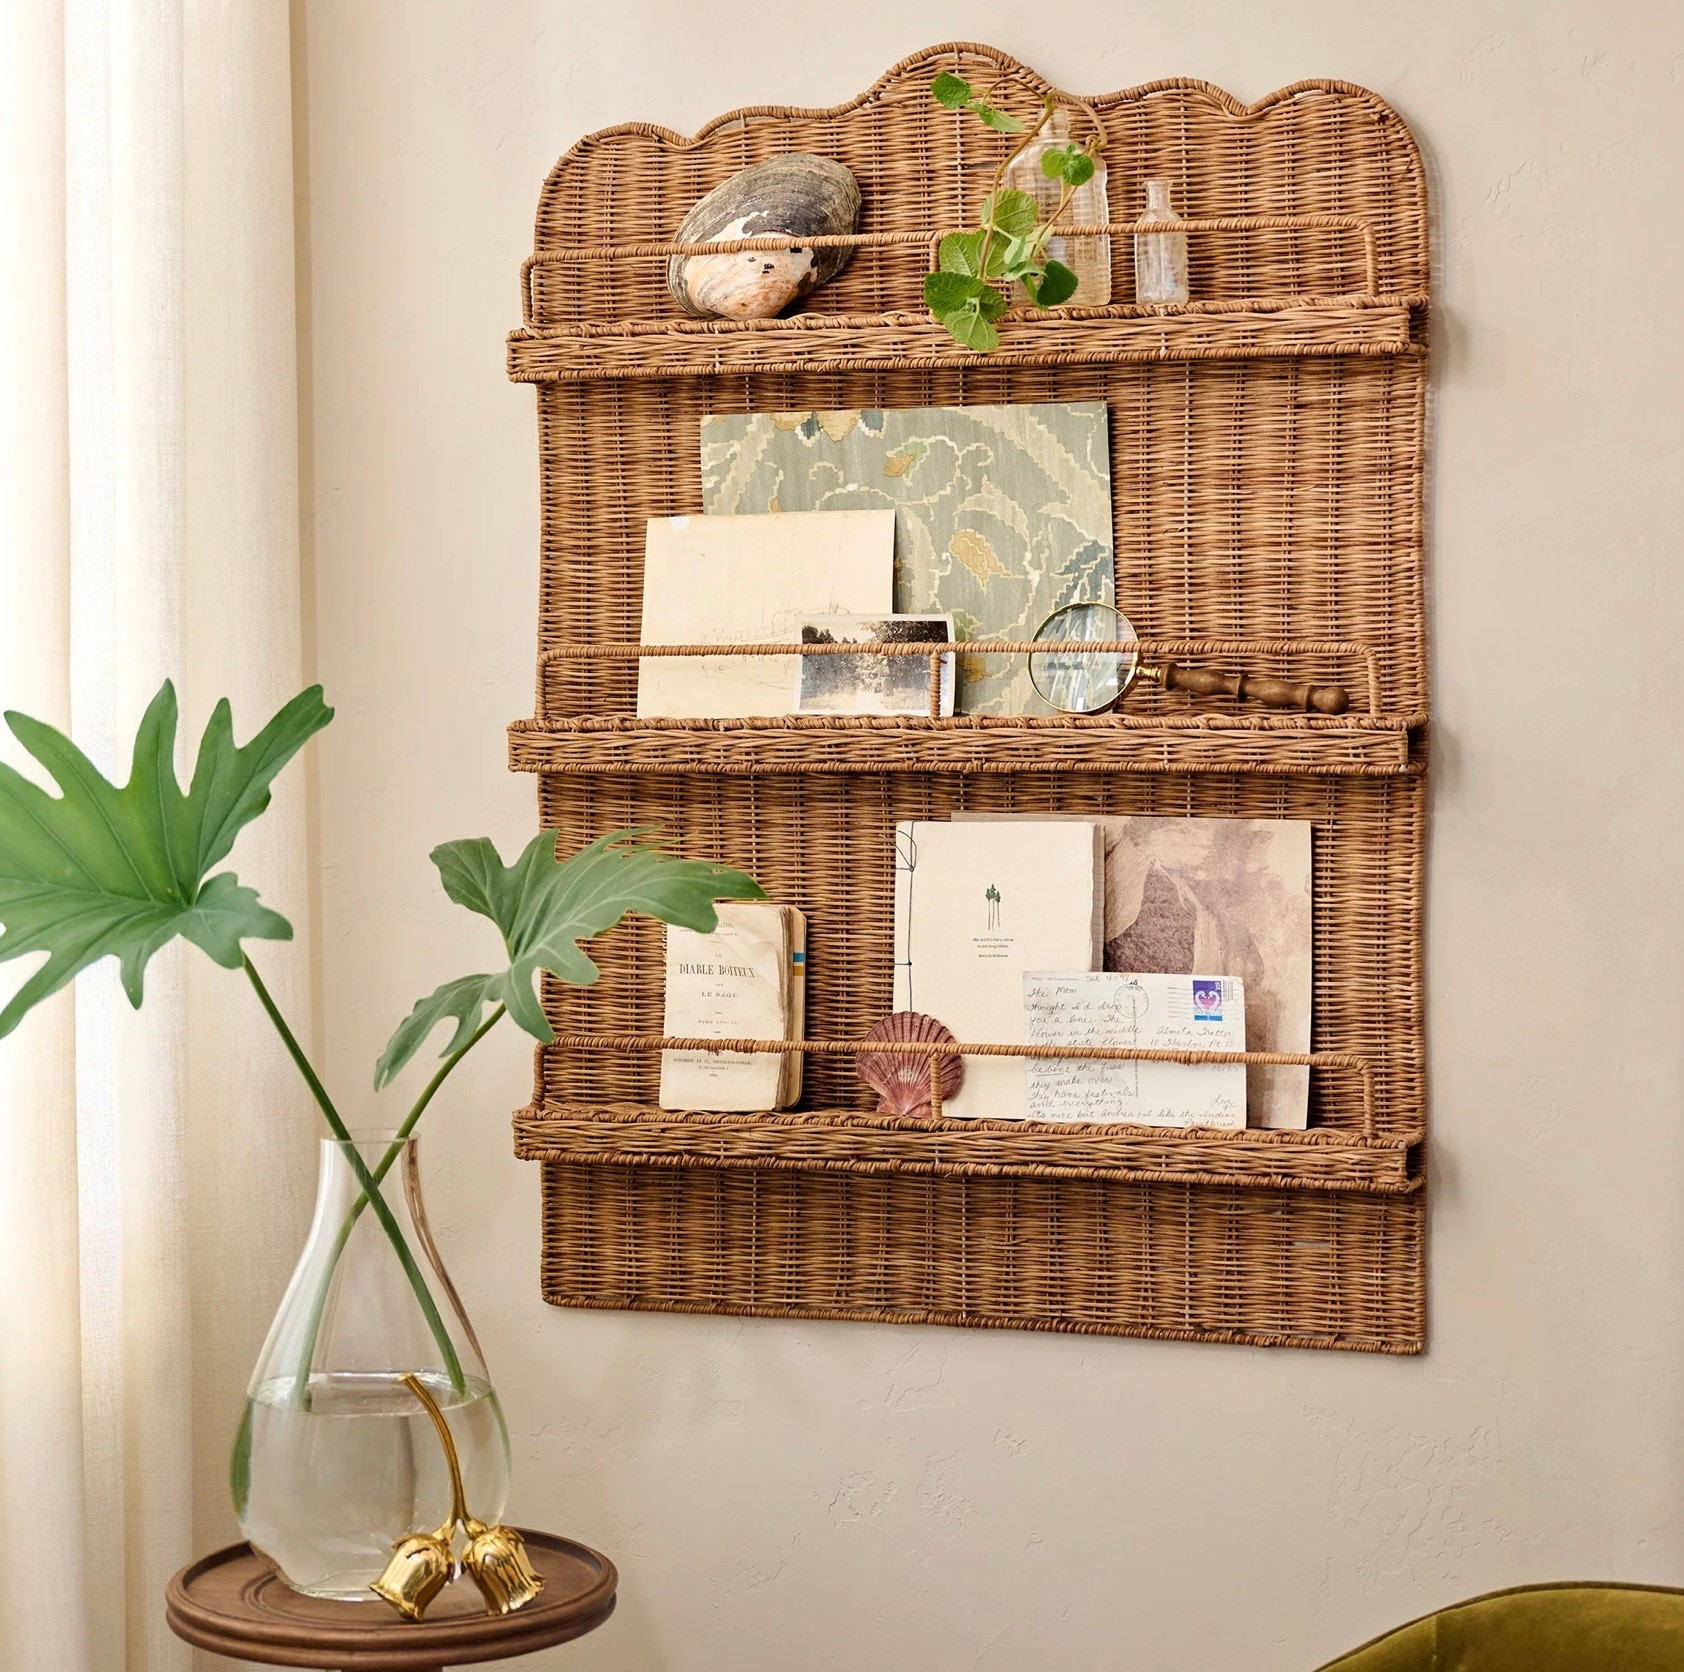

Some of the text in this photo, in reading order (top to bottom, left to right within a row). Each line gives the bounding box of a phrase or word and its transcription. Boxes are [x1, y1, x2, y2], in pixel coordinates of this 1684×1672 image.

[679, 963, 714, 976] DIABLE
[1056, 986, 1077, 996] Mom
[1098, 1002, 1122, 1012] drop
[1030, 1016, 1048, 1028] you
[1029, 1028, 1063, 1040] flower
[1085, 1026, 1103, 1036] the
[1105, 1025, 1142, 1035] middle
[1055, 1076, 1084, 1086] make
[1054, 1088, 1080, 1098] have
[1085, 1086, 1135, 1098] festivals
[1030, 1100, 1054, 1108] and
[1078, 1110, 1095, 1118] but
[1156, 1107, 1175, 1118] like
[1179, 1109, 1196, 1118] the
